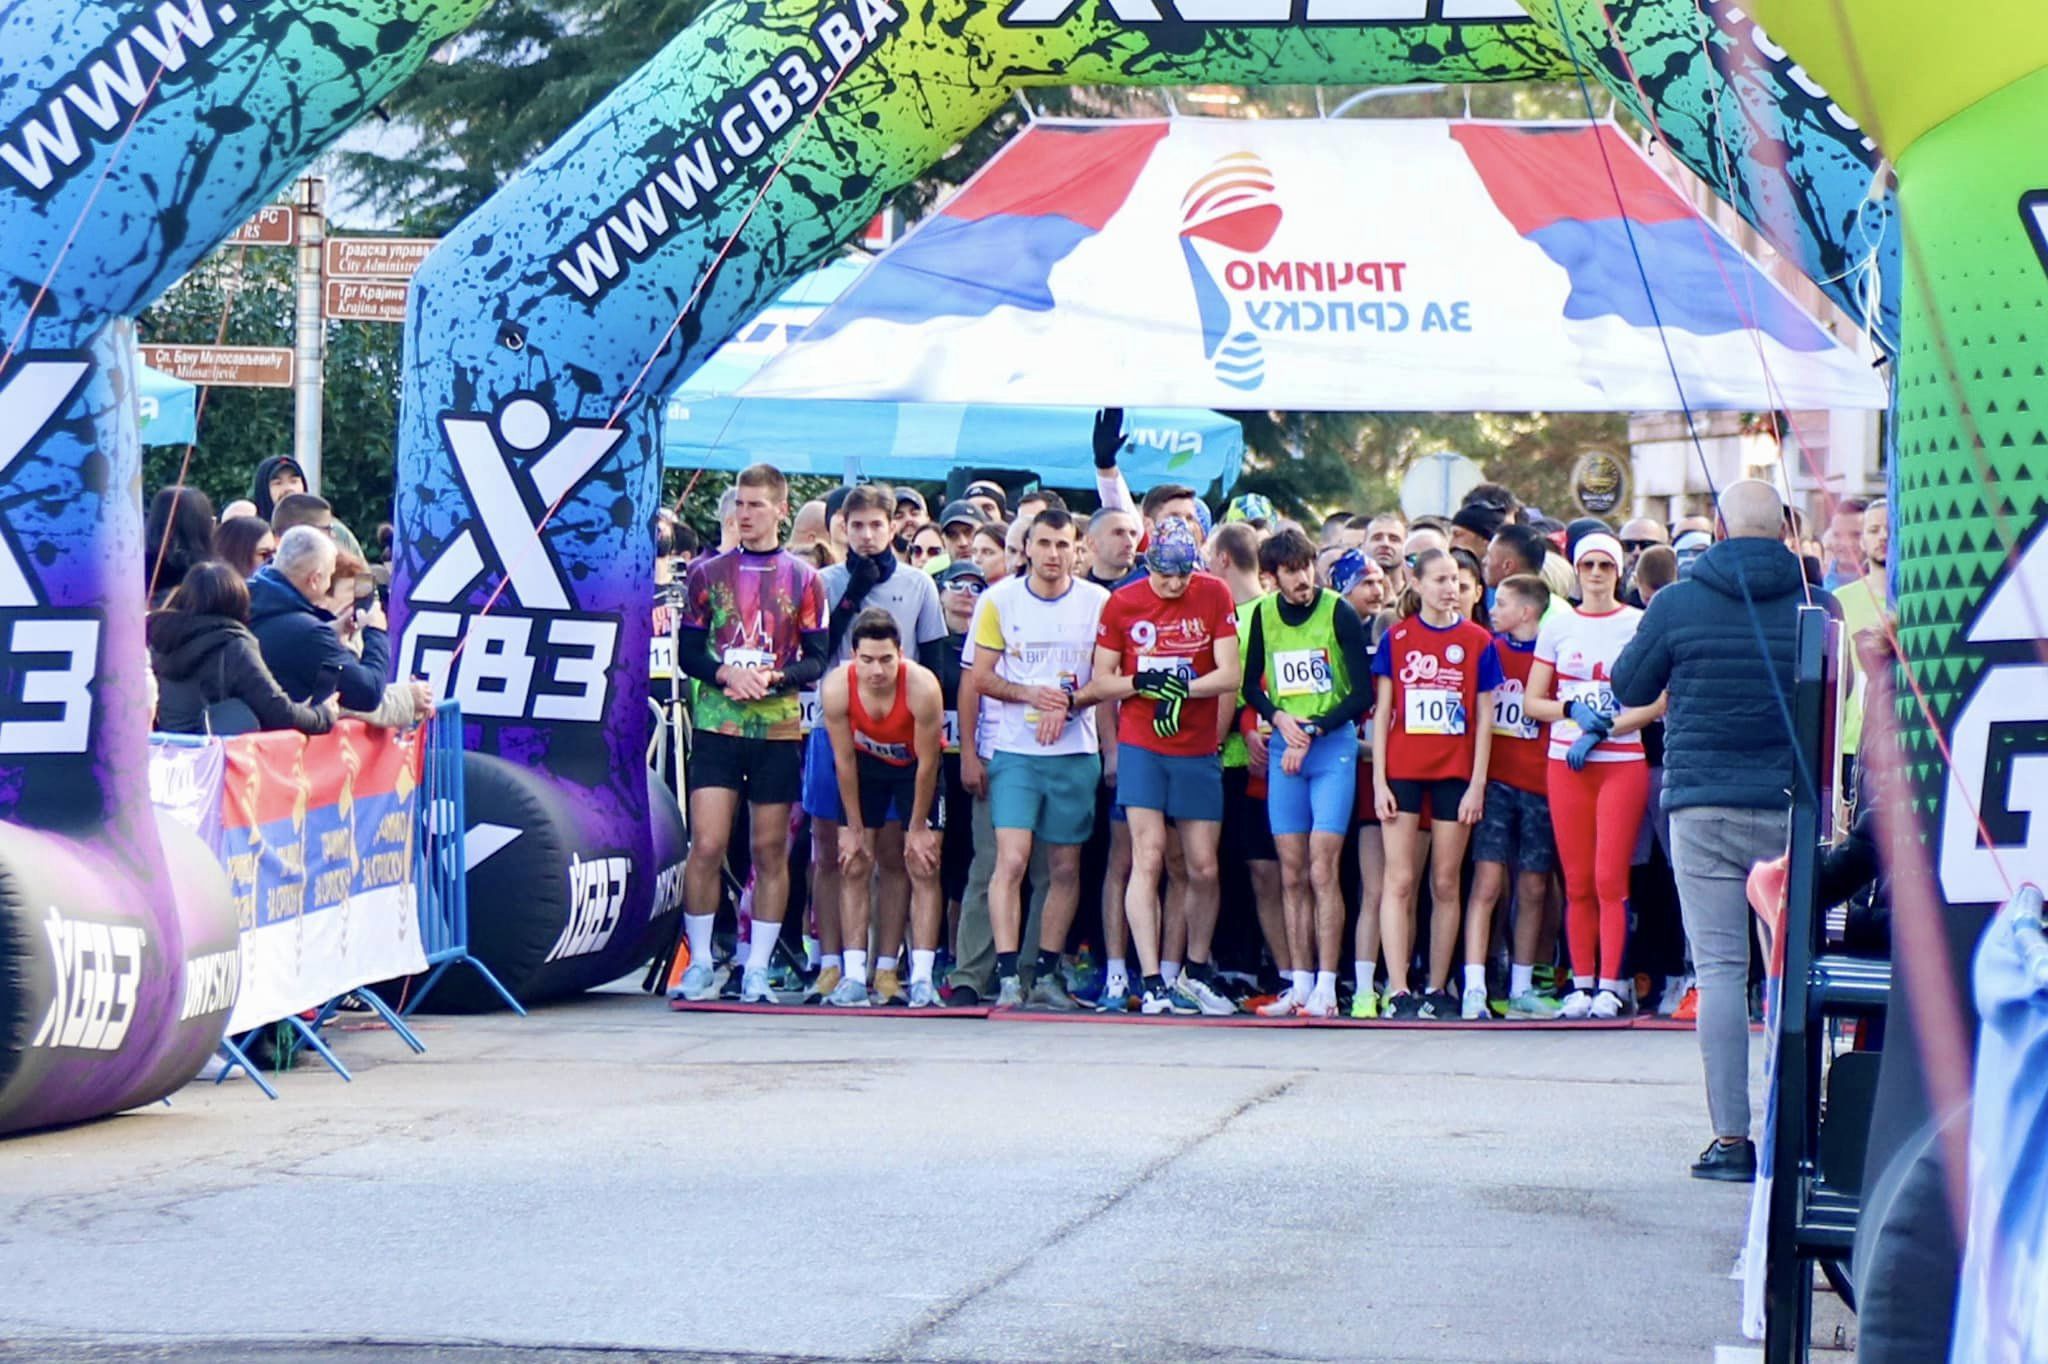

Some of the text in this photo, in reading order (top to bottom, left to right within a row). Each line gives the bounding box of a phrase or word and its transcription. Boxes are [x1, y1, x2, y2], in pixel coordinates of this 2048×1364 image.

[340, 242, 387, 260] Градска
[396, 610, 619, 722] GB3
[1283, 660, 1324, 683] 066
[1416, 701, 1458, 721] 107
